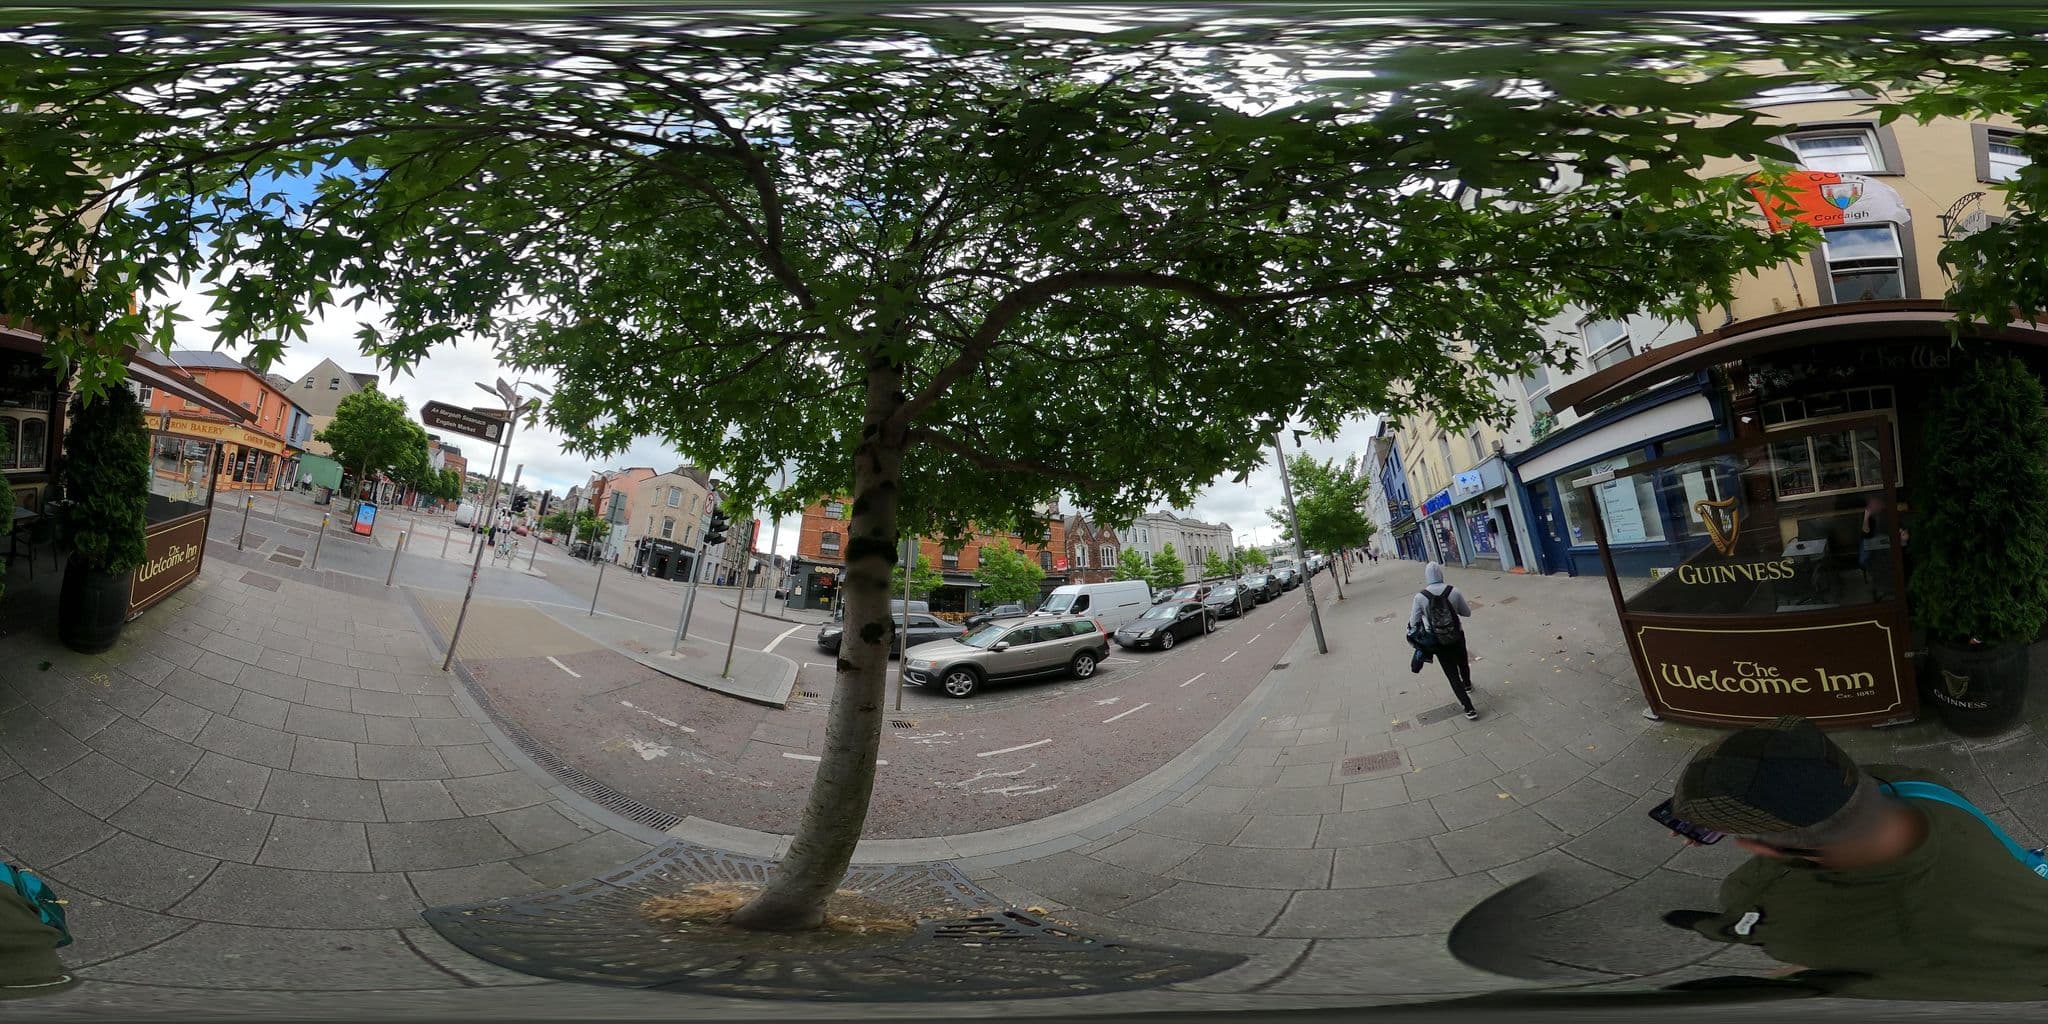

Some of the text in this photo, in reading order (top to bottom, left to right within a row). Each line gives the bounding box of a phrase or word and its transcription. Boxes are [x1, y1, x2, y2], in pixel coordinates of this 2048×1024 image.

[1814, 211, 1869, 221] Corcaigh
[191, 423, 224, 435] BAKERY
[169, 545, 180, 557] The
[140, 544, 198, 582] Welcome Inn
[1678, 560, 1795, 585] GUINNESS
[1733, 660, 1780, 677] The
[1661, 663, 1875, 694] Welcome Inn
